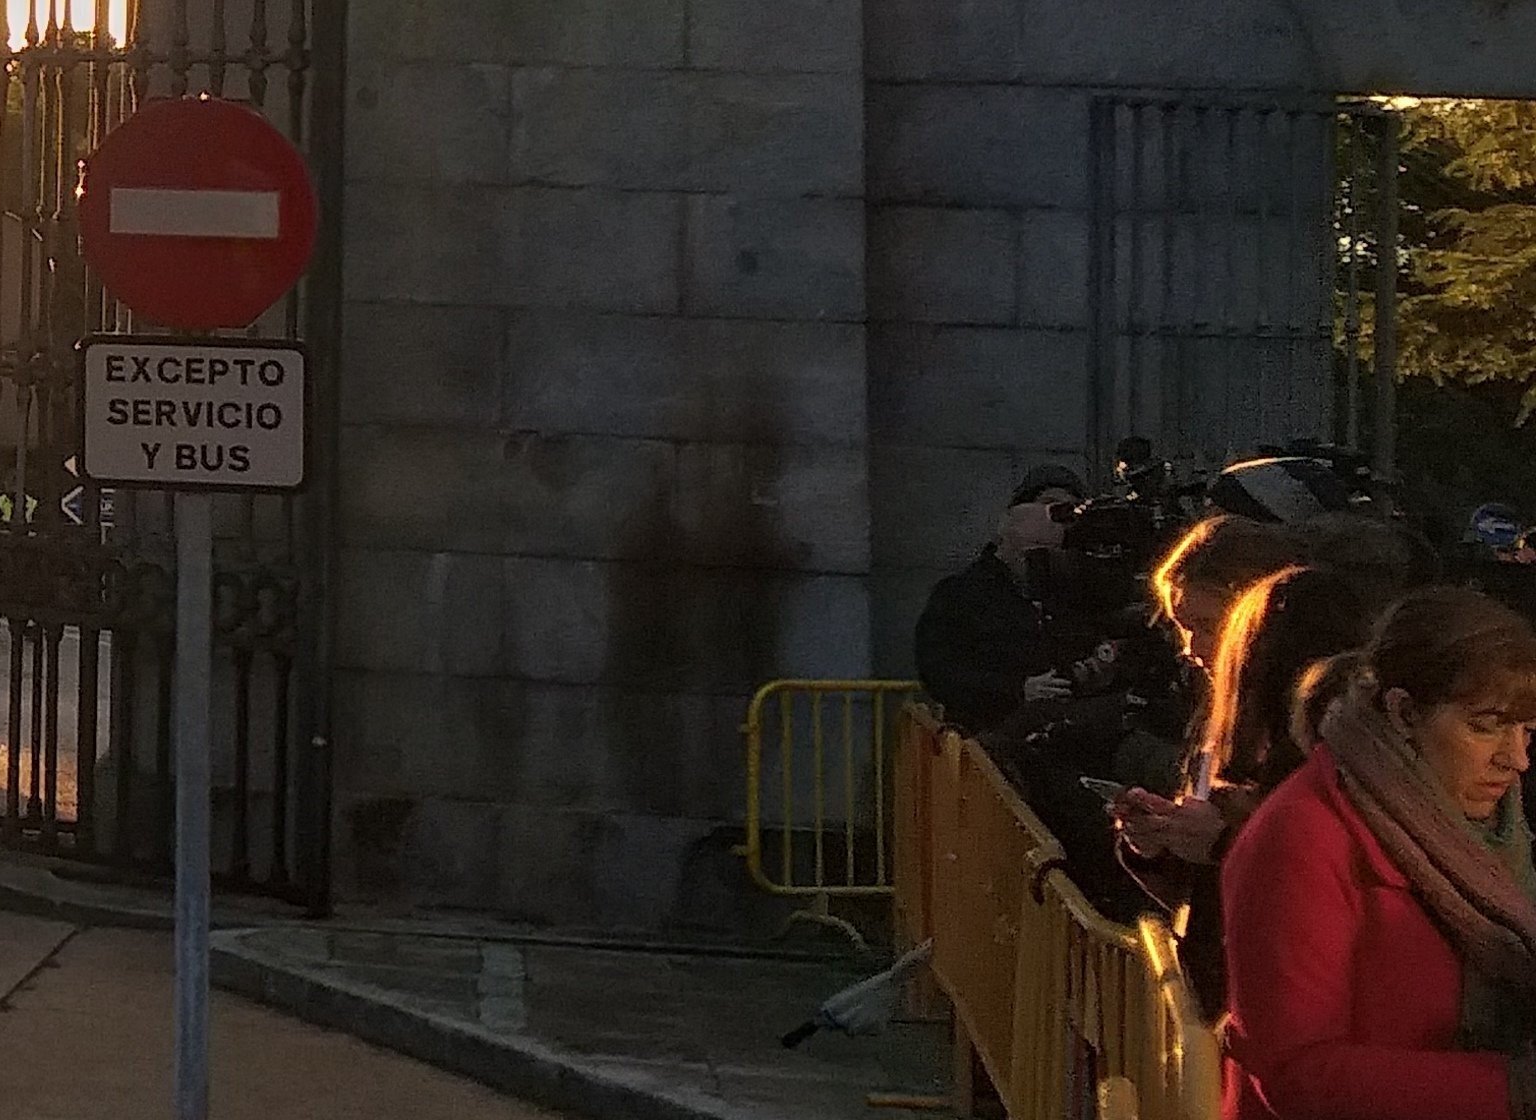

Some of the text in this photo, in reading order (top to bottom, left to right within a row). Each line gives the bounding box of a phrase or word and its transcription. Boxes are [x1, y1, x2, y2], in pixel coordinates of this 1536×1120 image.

[105, 355, 285, 386] EXCEPTO
[106, 398, 282, 430] SERVICIO
[140, 442, 251, 472] Y BUS
